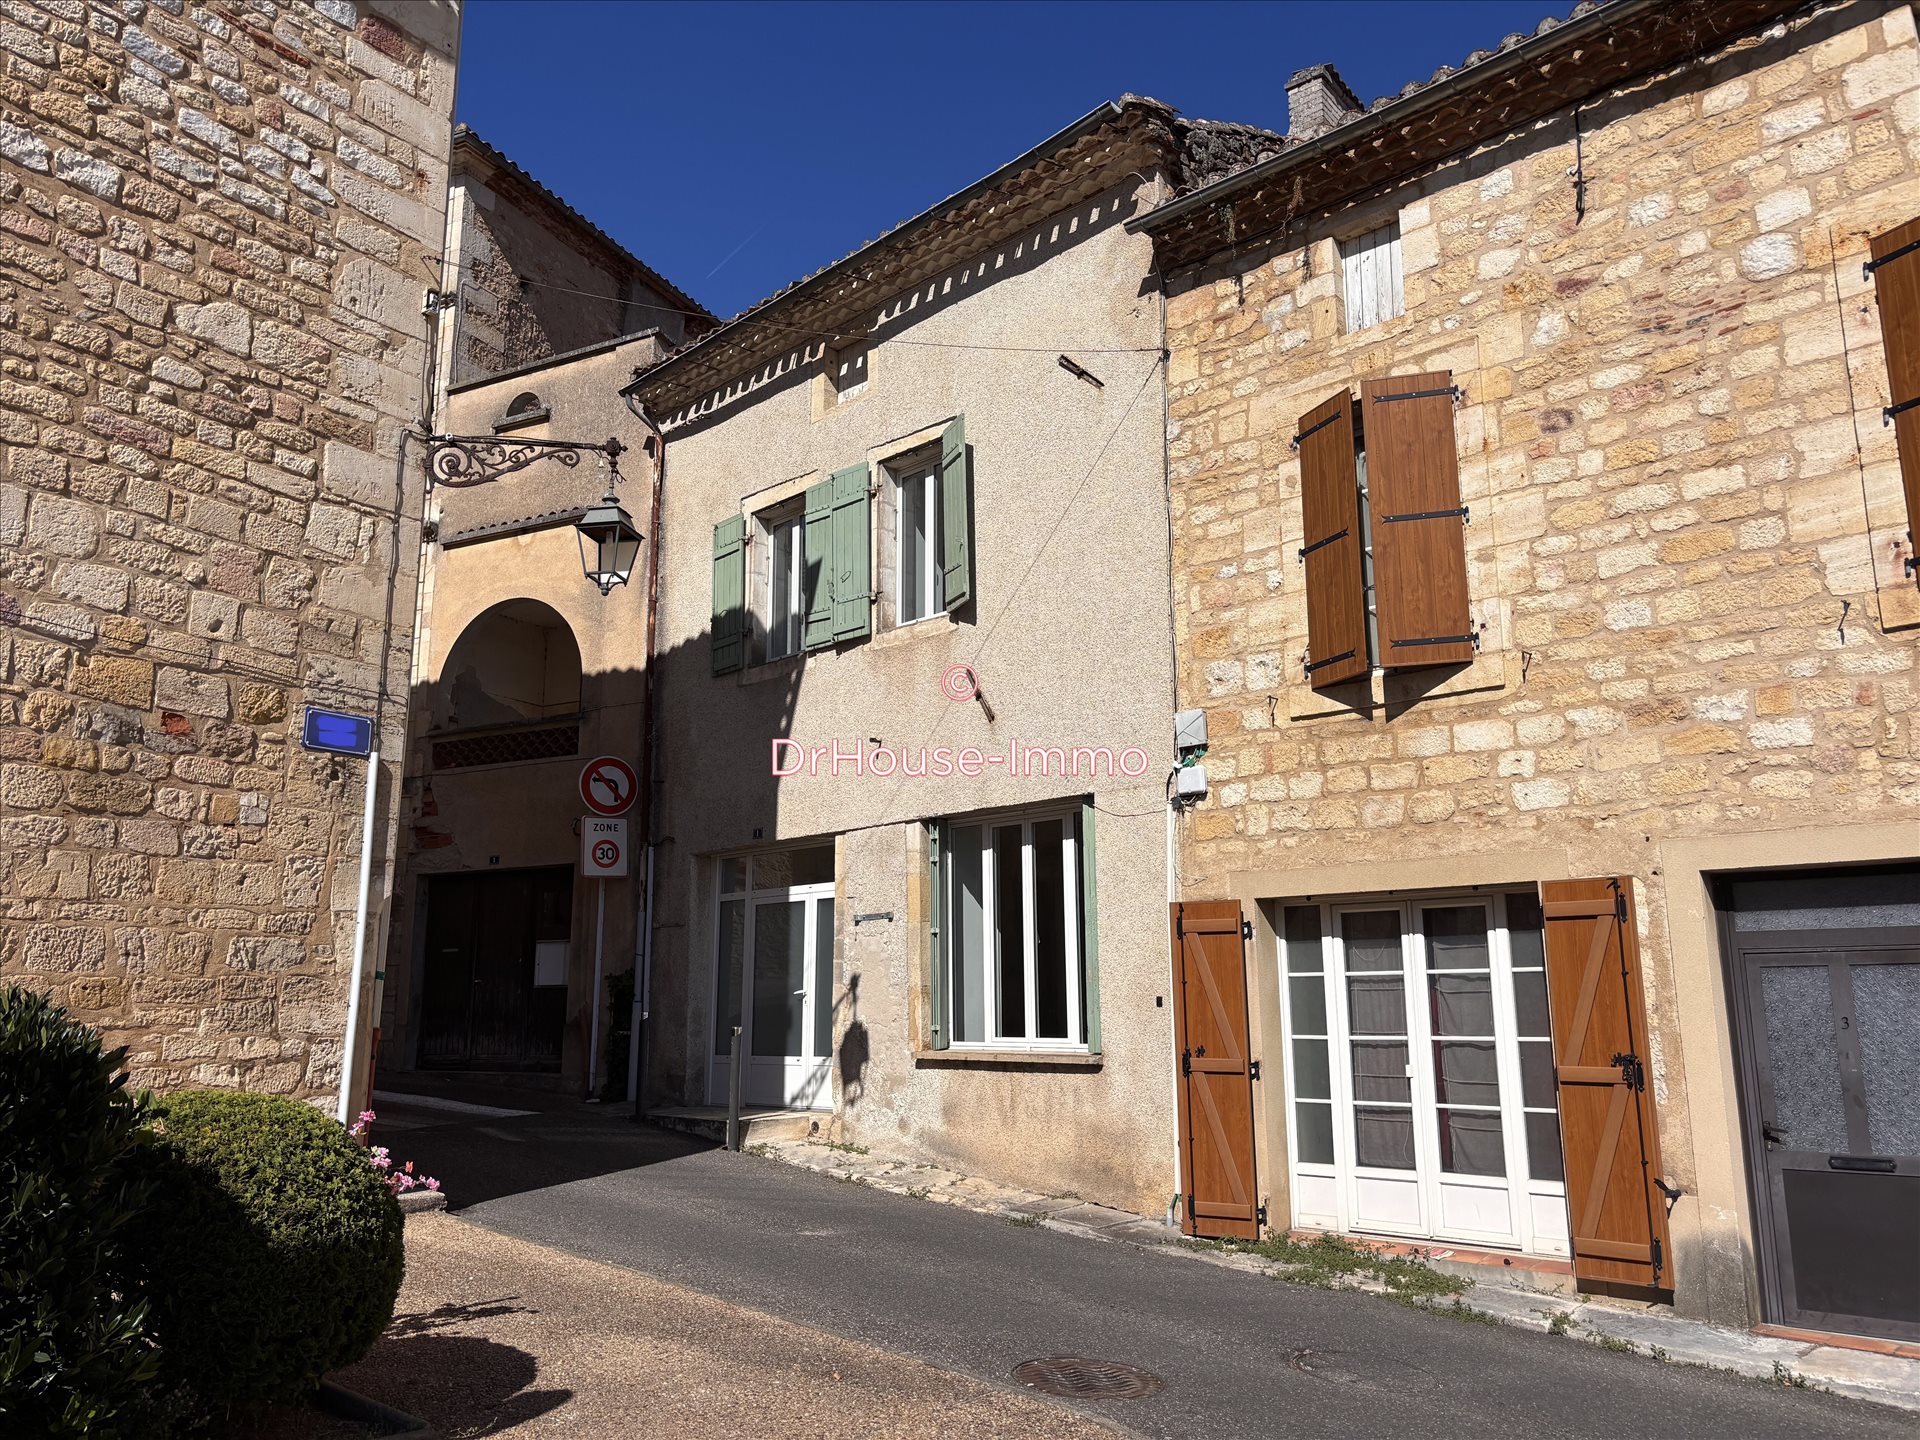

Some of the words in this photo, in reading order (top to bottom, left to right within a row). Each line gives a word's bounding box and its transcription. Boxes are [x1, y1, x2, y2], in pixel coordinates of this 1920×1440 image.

[593, 823, 619, 832] ZONE
[597, 847, 615, 860] 30
[1841, 1016, 1850, 1030] 3
